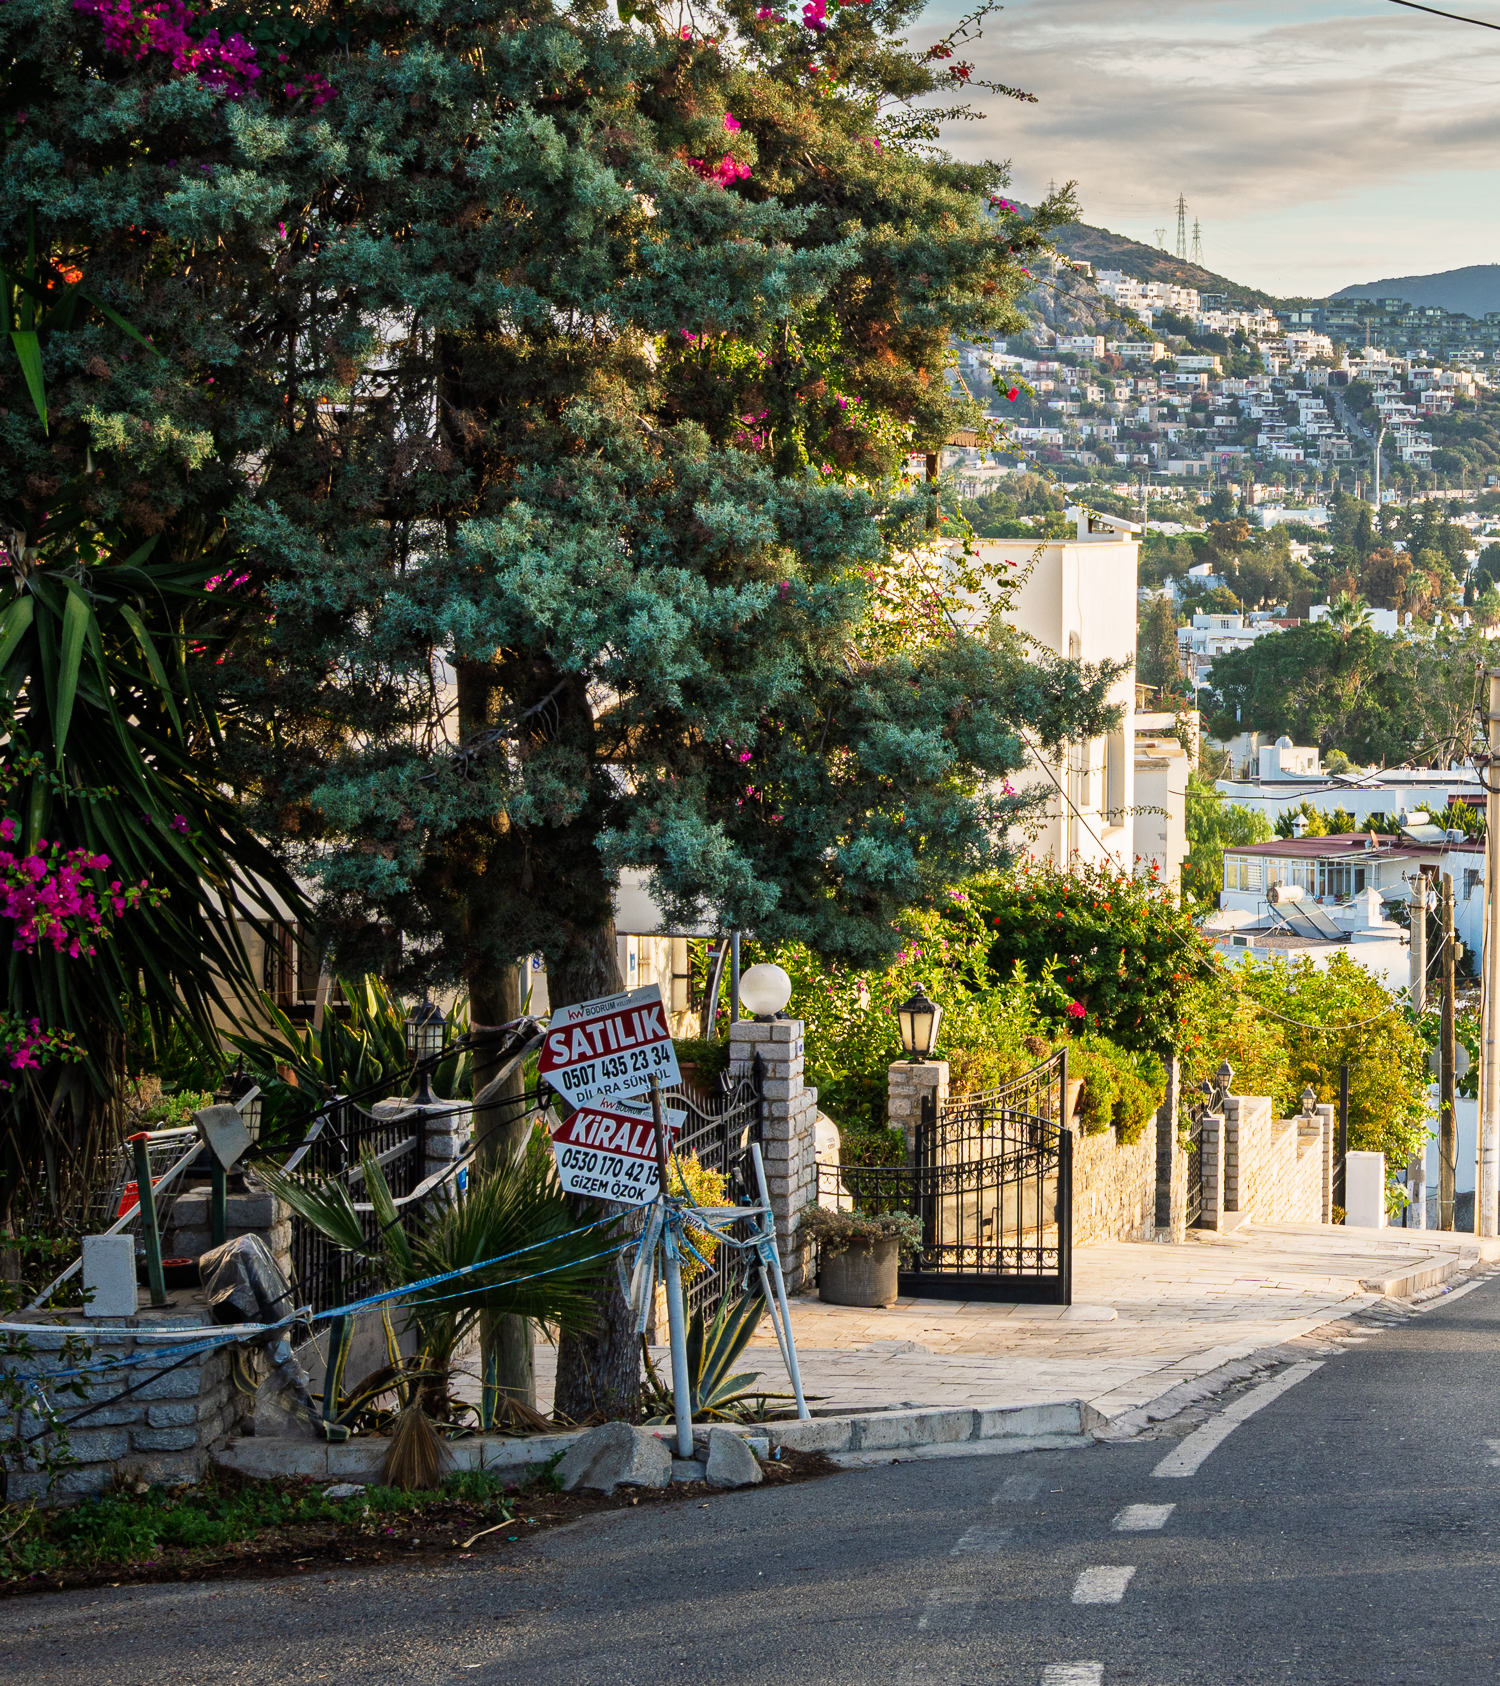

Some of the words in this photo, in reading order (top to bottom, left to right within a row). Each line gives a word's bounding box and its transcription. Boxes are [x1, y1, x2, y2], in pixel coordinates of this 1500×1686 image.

[585, 1002, 616, 1016] BODRUM
[549, 1006, 667, 1064] SATILIK
[562, 1063, 596, 1091] 0507
[601, 1055, 628, 1079] 435
[630, 1049, 649, 1072] 23
[651, 1043, 671, 1066] 34
[600, 1097, 617, 1110] kw
[561, 1147, 598, 1172] 0530
[599, 1155, 624, 1178] 170
[624, 1161, 645, 1183] 42
[645, 1165, 660, 1186] 15
[610, 1180, 647, 1201] ÖZOK
